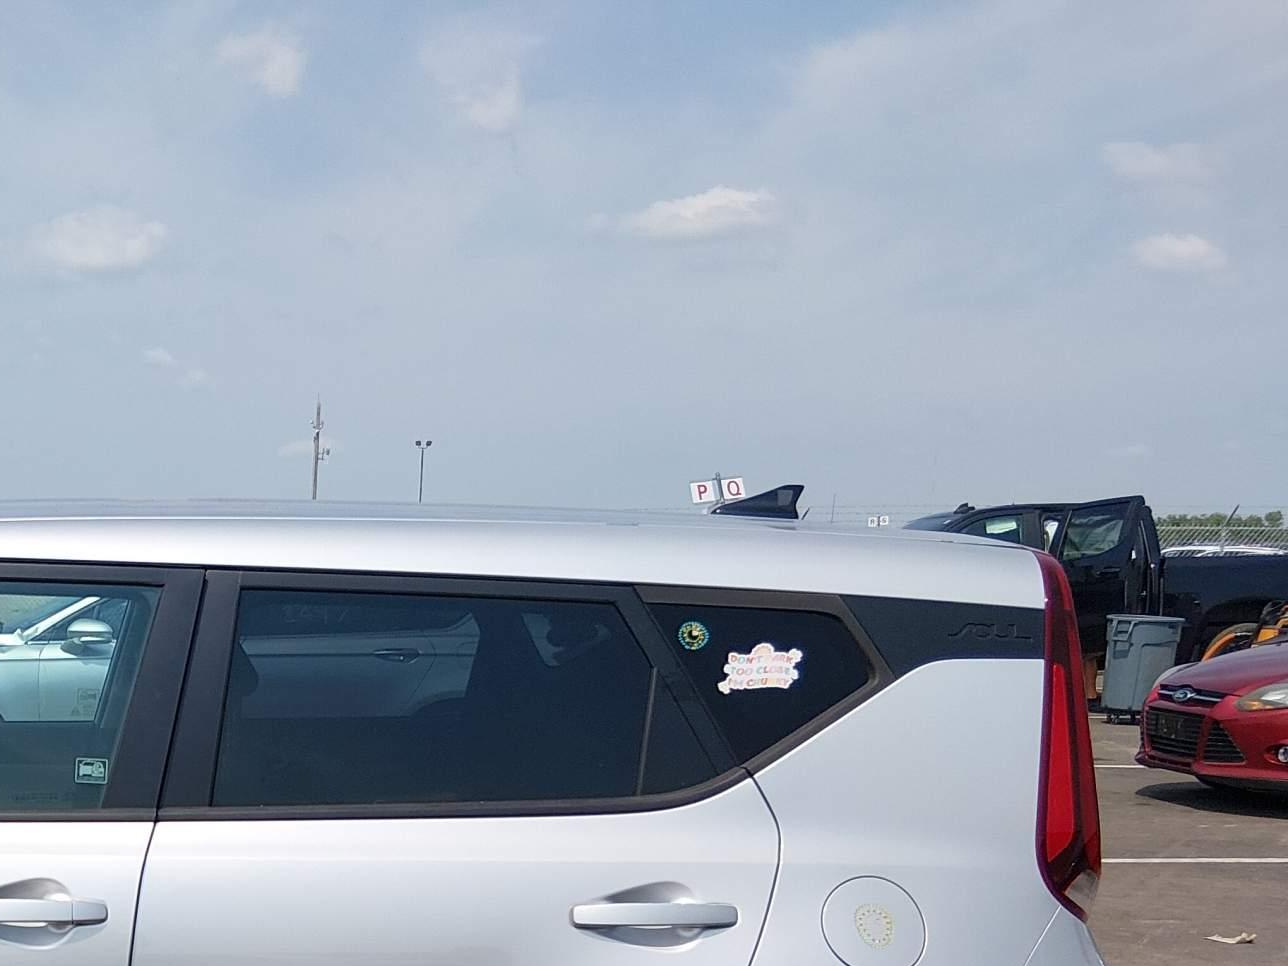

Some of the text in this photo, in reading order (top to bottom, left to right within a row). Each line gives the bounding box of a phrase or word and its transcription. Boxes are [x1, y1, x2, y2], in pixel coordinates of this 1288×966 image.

[696, 480, 742, 501] P Q
[947, 622, 1034, 641] SOUL
[730, 665, 791, 676] TOO CLOSE
